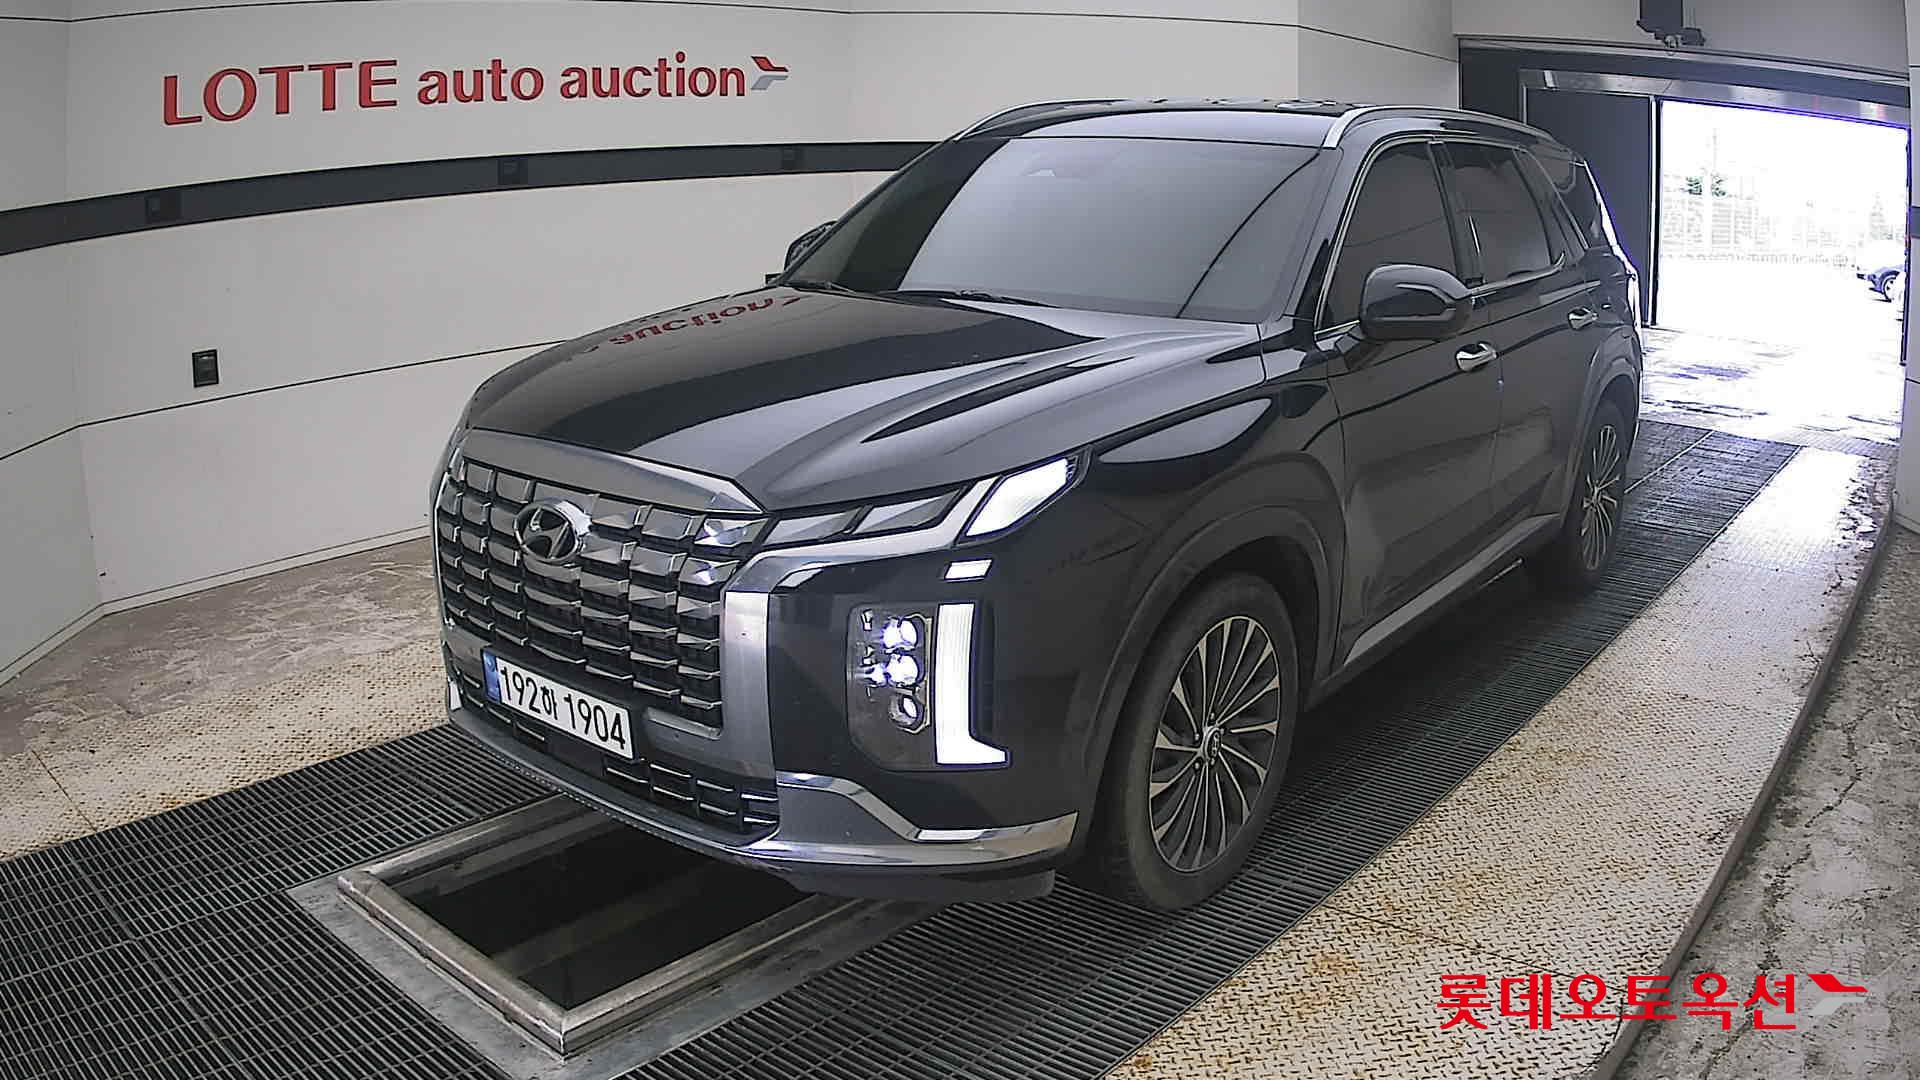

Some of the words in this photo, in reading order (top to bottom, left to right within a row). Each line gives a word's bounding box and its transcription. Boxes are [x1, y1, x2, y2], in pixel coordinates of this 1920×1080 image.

[163, 59, 398, 126] LOTTE
[417, 58, 545, 105] auto
[559, 51, 745, 98] auction
[501, 666, 558, 721] 192하
[564, 693, 626, 750] 1904
